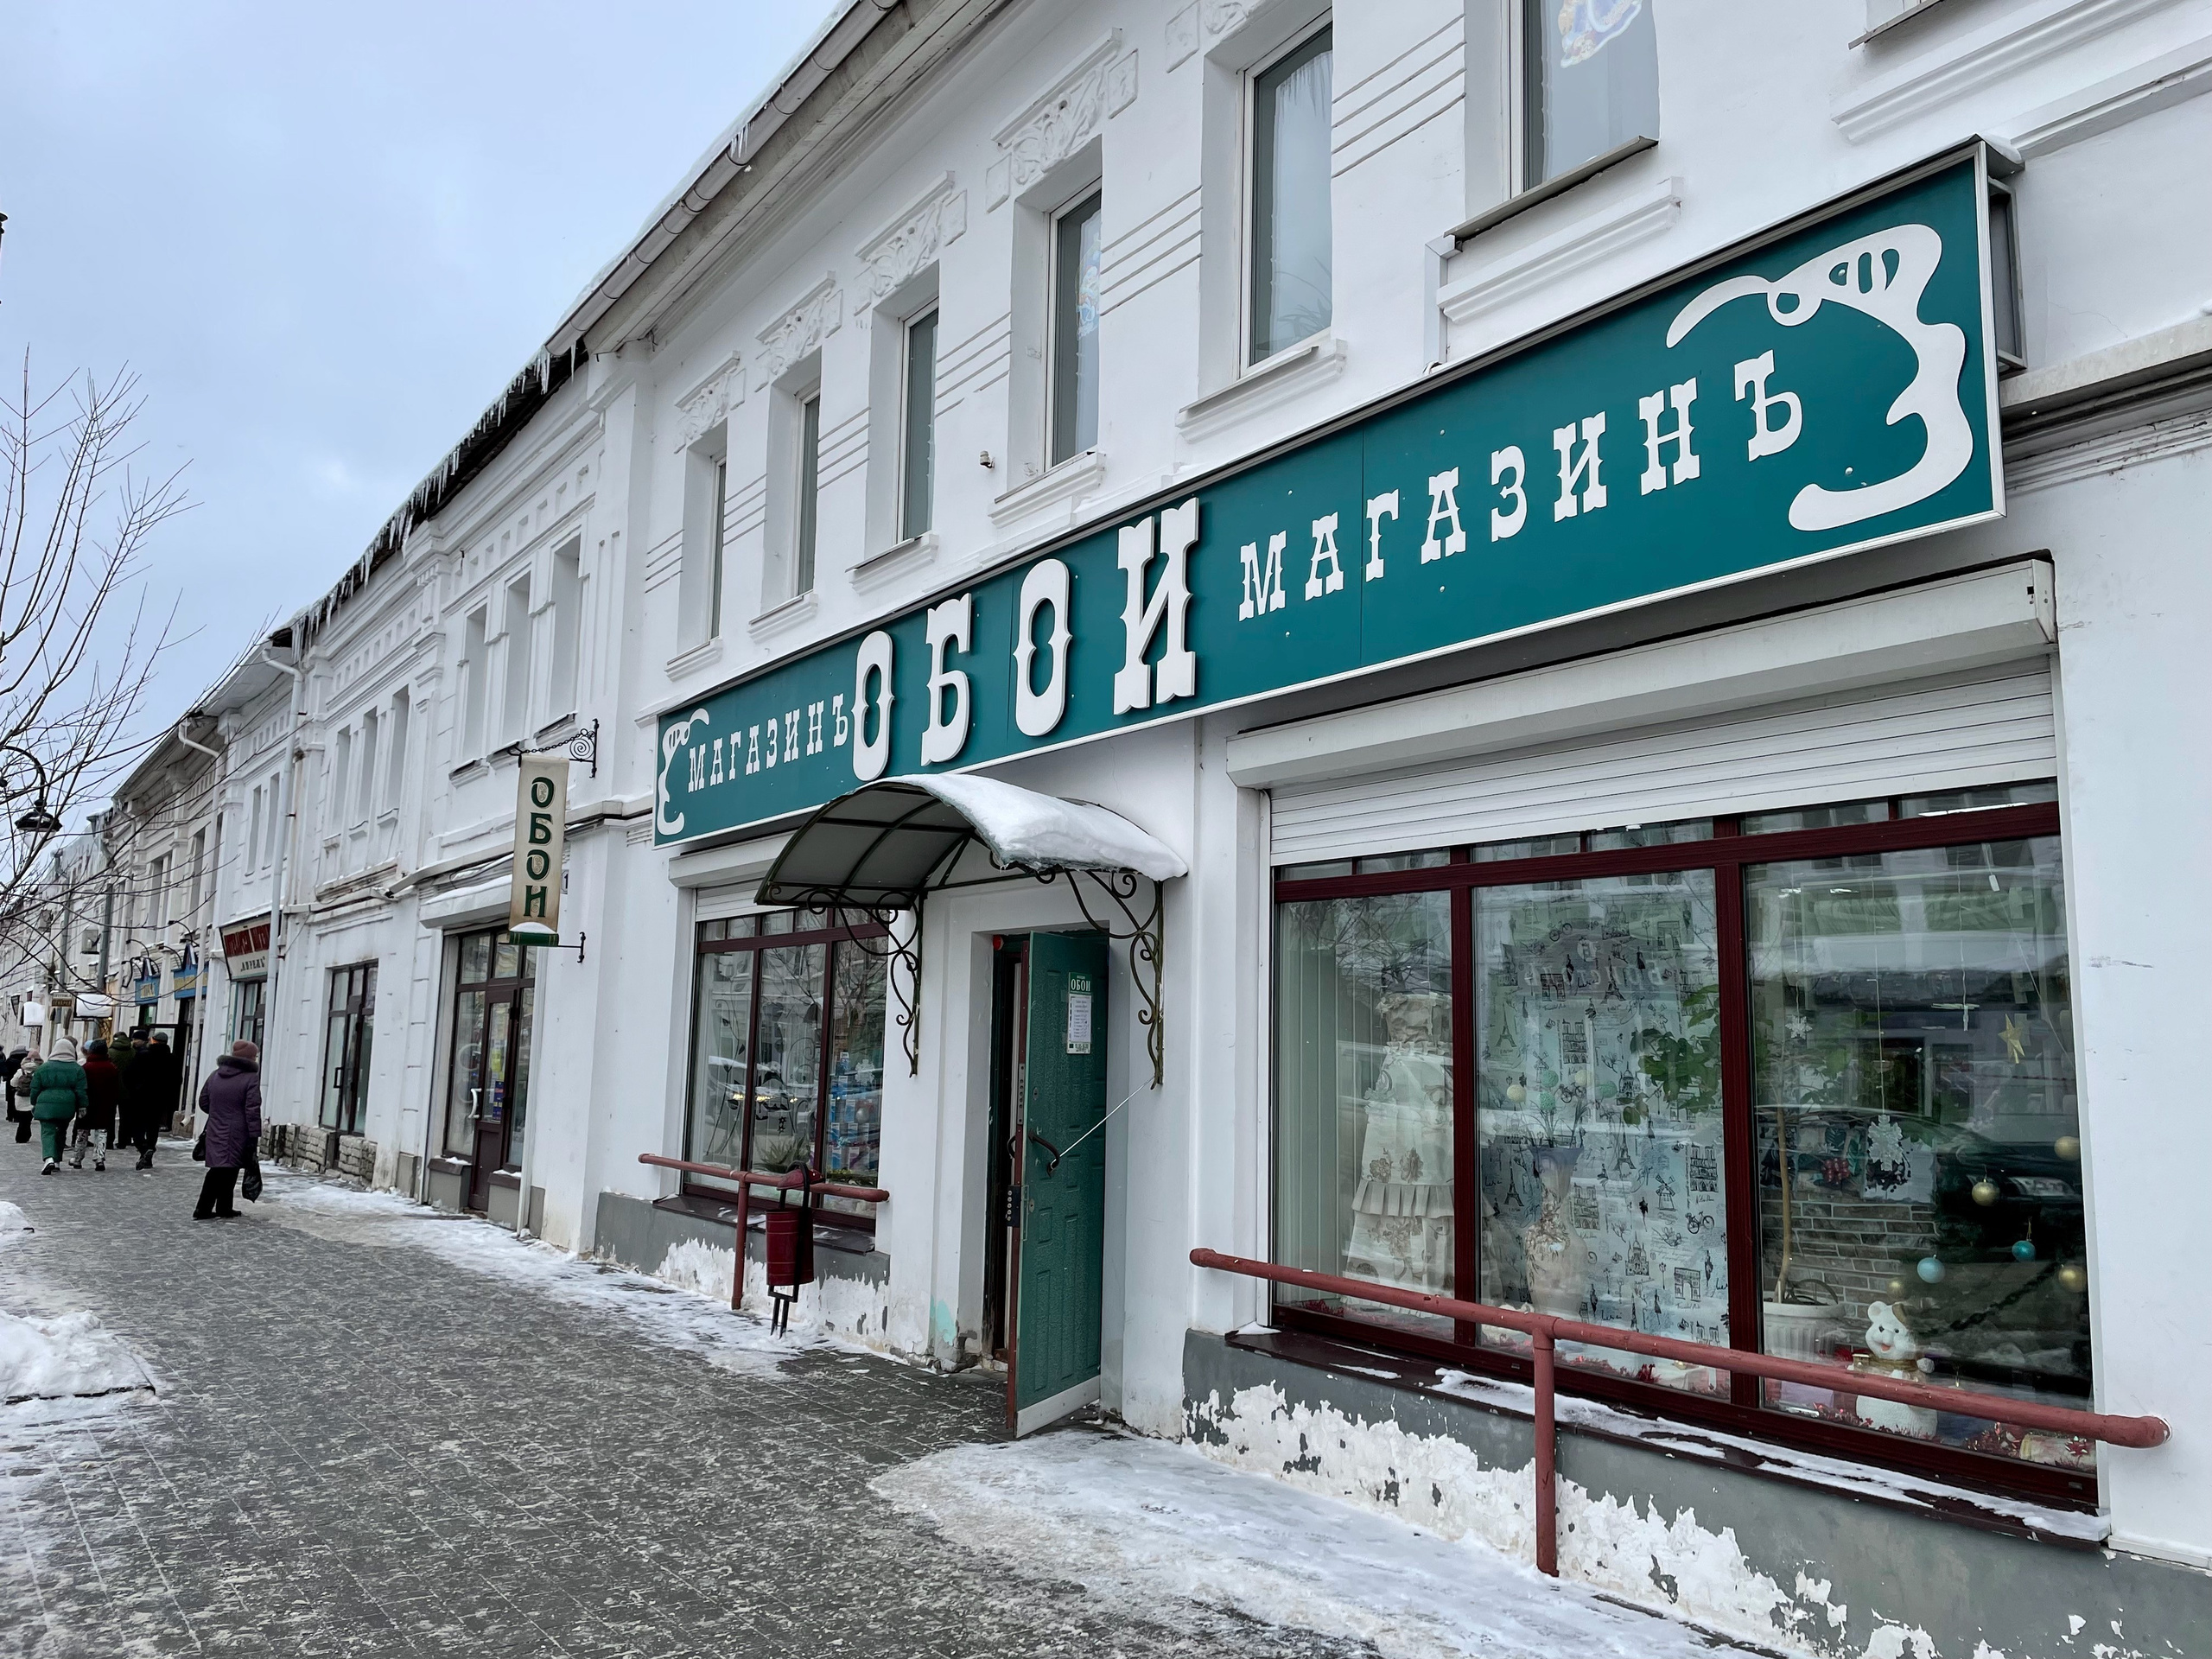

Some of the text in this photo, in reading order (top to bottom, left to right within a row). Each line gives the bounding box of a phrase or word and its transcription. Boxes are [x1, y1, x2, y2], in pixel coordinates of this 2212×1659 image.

[688, 349, 1803, 793] МАГАЗИНЪ ОБОИ МАГАЗИНЪ
[523, 776, 556, 918] ОБОИ
[1071, 978, 1091, 992] ОБОИ
